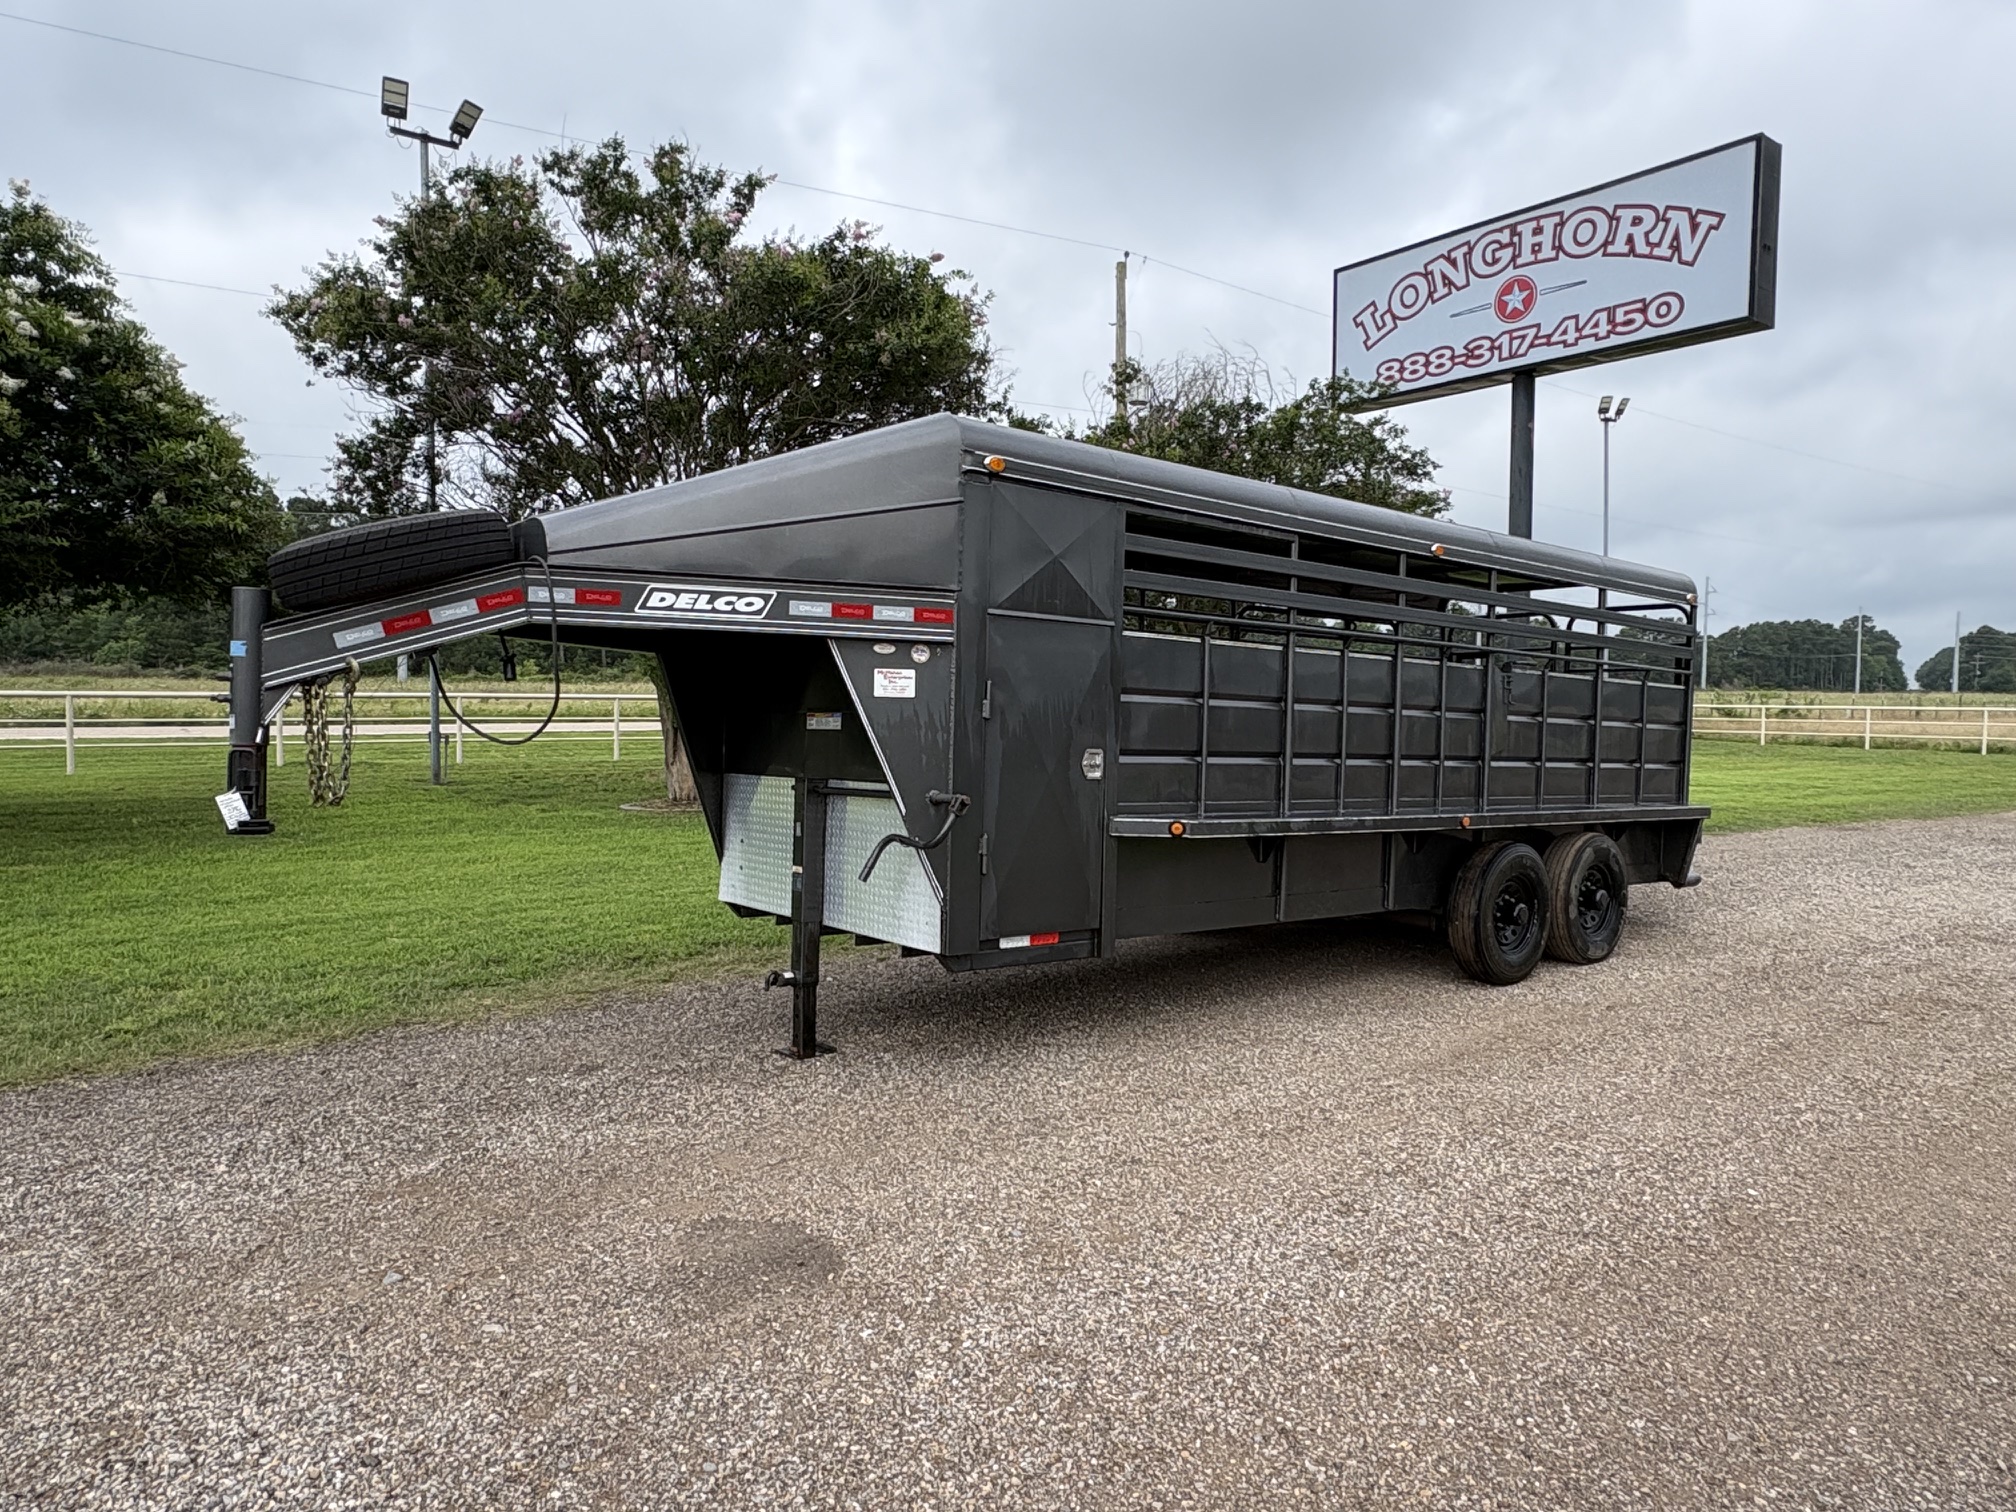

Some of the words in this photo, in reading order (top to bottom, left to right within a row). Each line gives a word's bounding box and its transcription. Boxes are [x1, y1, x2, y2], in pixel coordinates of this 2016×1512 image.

[1353, 204, 1726, 350] LONGHORN
[1376, 291, 1685, 384] 888-317-4450
[646, 591, 766, 613] DELCO
